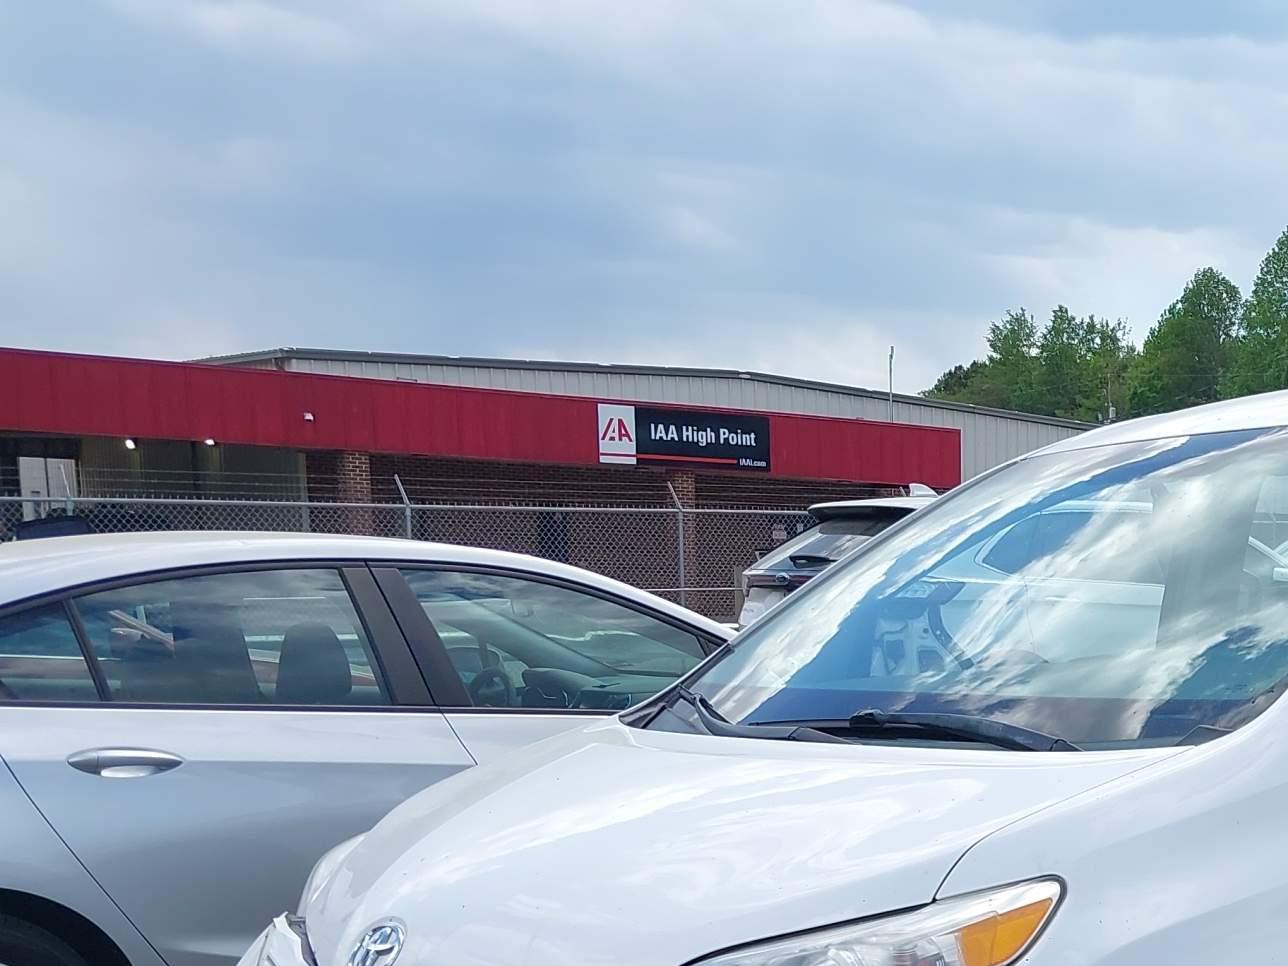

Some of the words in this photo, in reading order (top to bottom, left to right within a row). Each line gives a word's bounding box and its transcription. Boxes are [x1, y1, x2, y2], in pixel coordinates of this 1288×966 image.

[650, 423, 679, 441] IAA
[682, 425, 715, 446] High
[720, 428, 756, 446] Point
